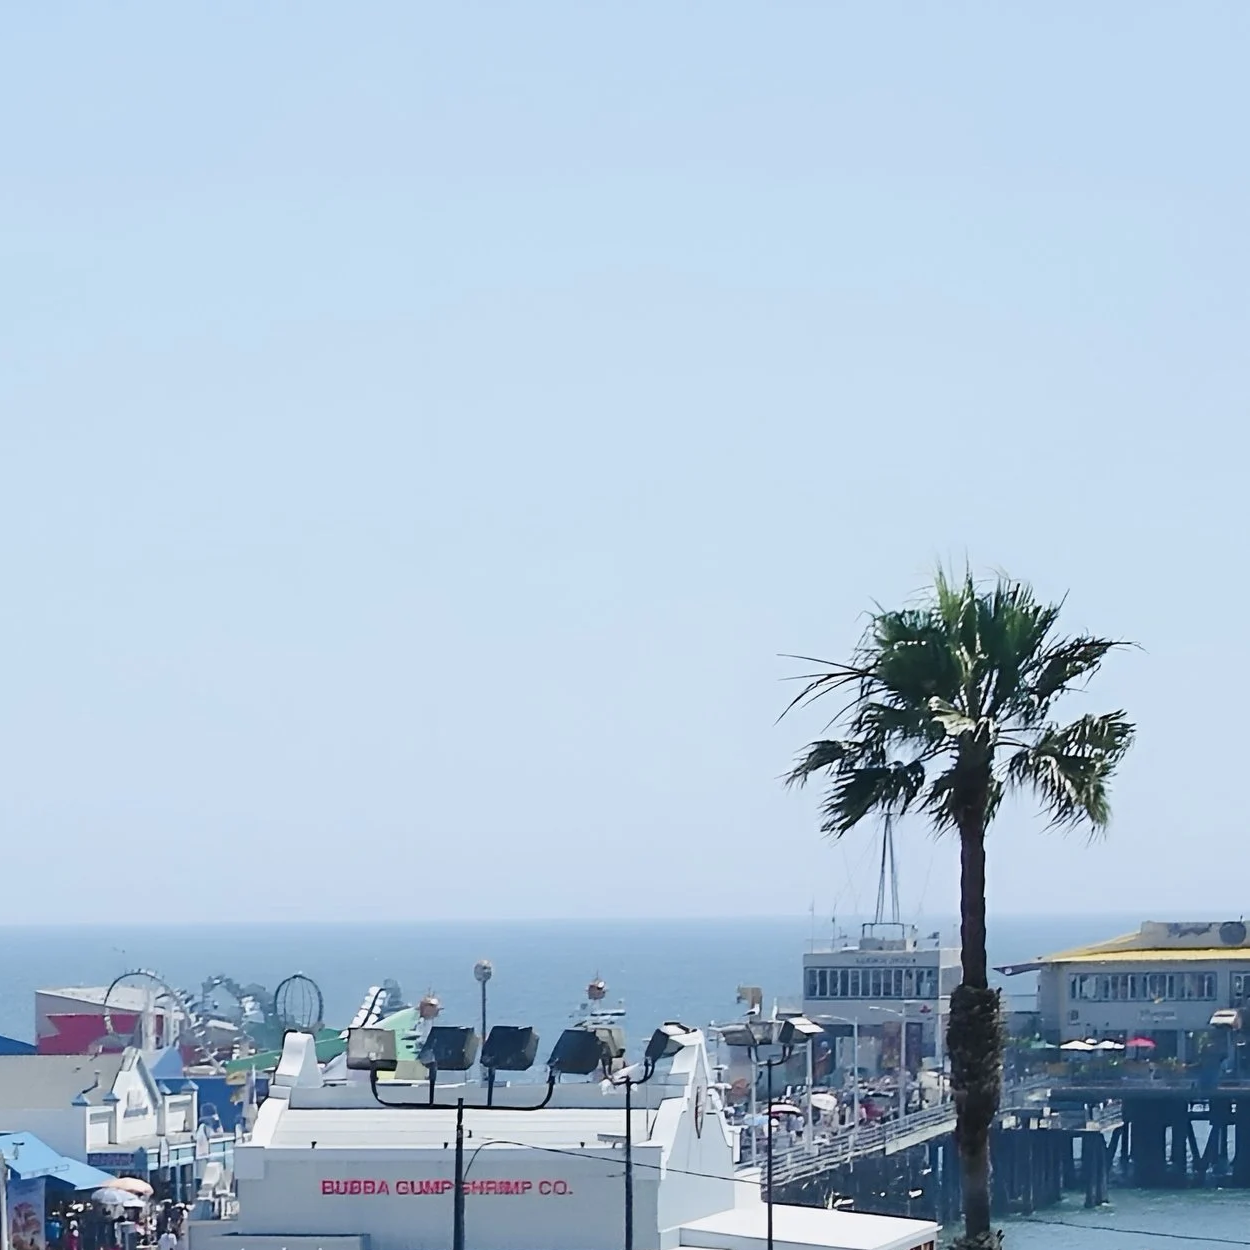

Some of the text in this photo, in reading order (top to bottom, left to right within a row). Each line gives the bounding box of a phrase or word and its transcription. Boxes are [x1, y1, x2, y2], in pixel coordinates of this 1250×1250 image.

[321, 1180, 390, 1195] BUBBA
[396, 1180, 454, 1195] GUMP
[539, 1180, 573, 1195] CO.
